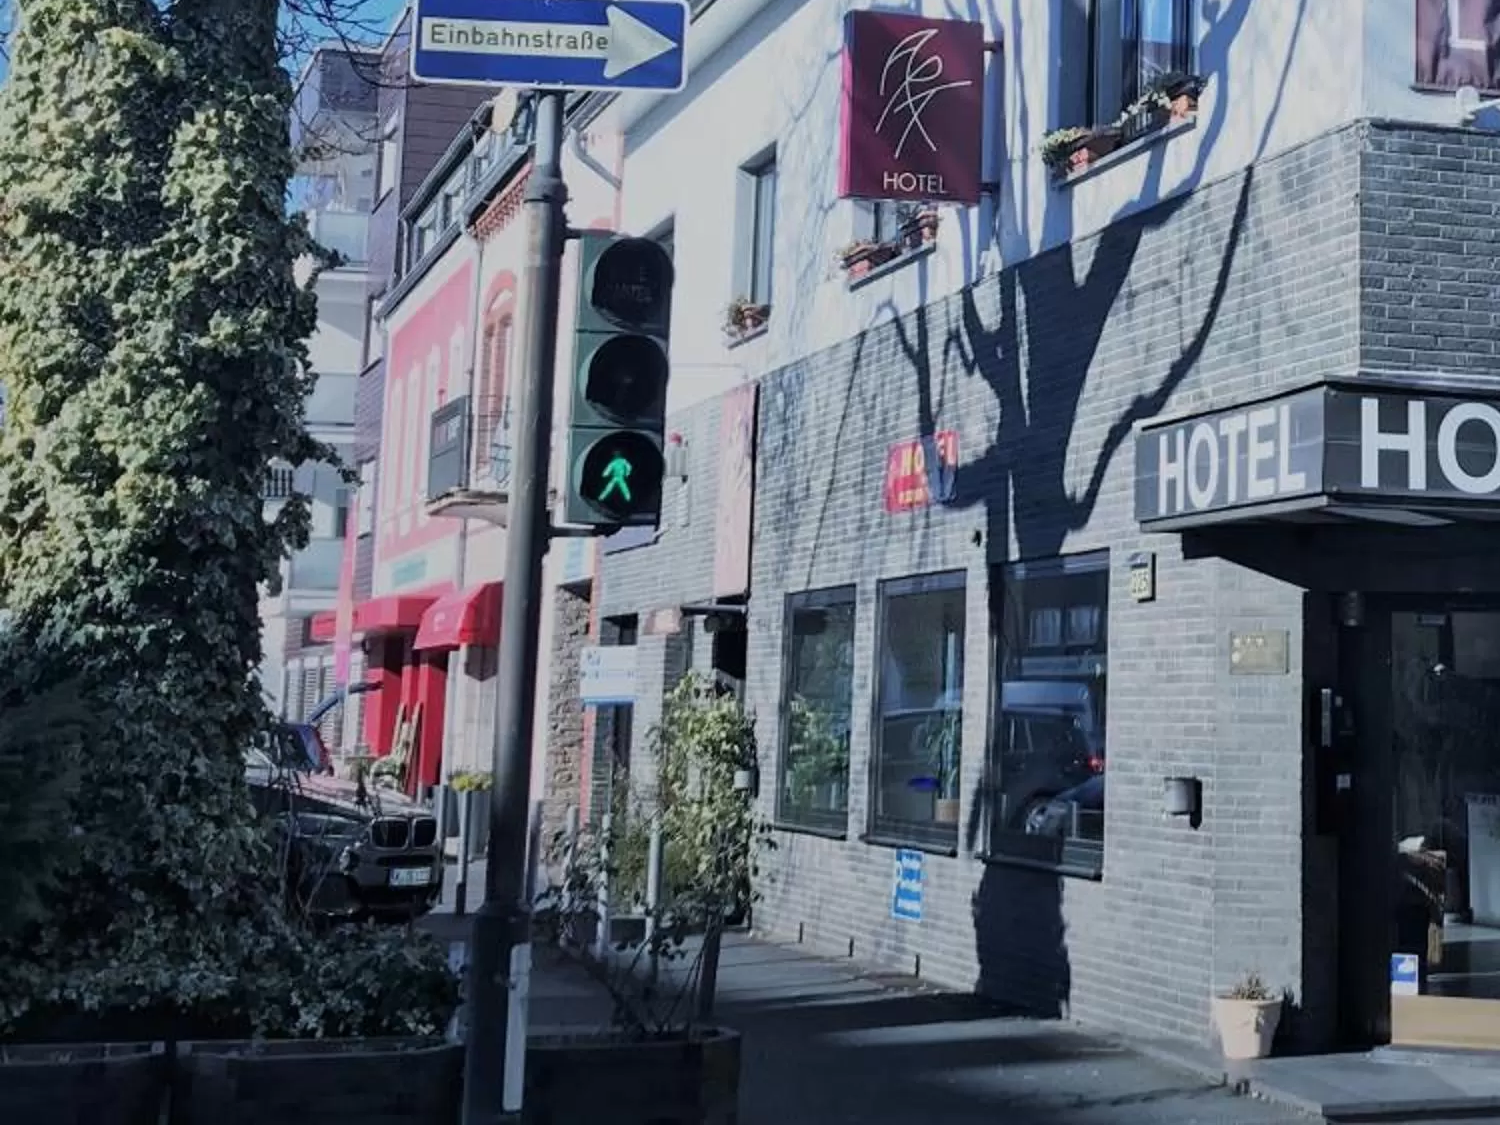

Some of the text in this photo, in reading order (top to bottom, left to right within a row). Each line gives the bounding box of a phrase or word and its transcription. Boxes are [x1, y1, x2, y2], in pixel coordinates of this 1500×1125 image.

[430, 23, 609, 51] Einbahnstraße
[882, 171, 948, 194] HOTEL
[1158, 403, 1306, 516] HOTEL
